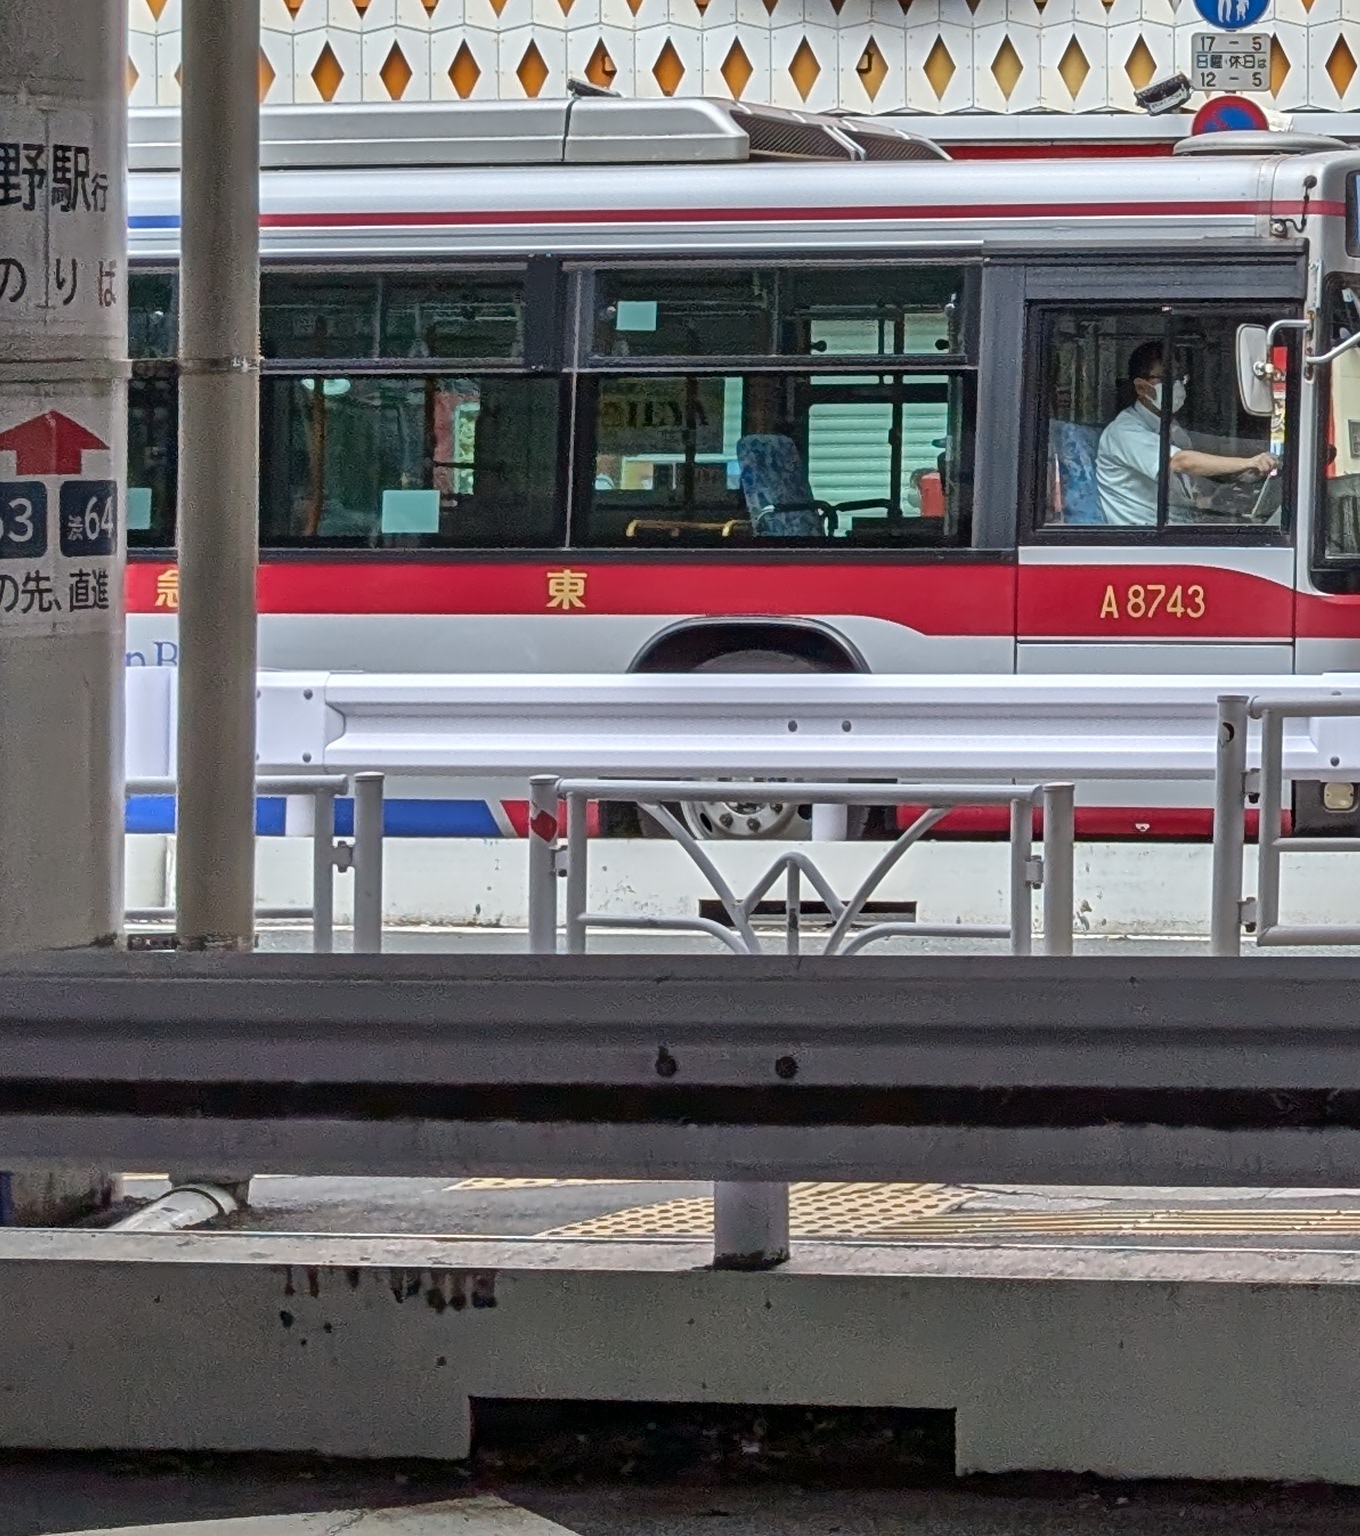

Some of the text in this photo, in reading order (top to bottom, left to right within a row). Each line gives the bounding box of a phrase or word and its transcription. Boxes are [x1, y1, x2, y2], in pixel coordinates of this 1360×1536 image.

[1200, 35, 1216, 52] 17
[1251, 35, 1263, 52] 5
[1200, 71, 1217, 88] 12
[1251, 71, 1263, 88] 5
[0, 142, 109, 213] 野駅行
[0, 497, 34, 543] 3
[546, 569, 589, 611] 東
